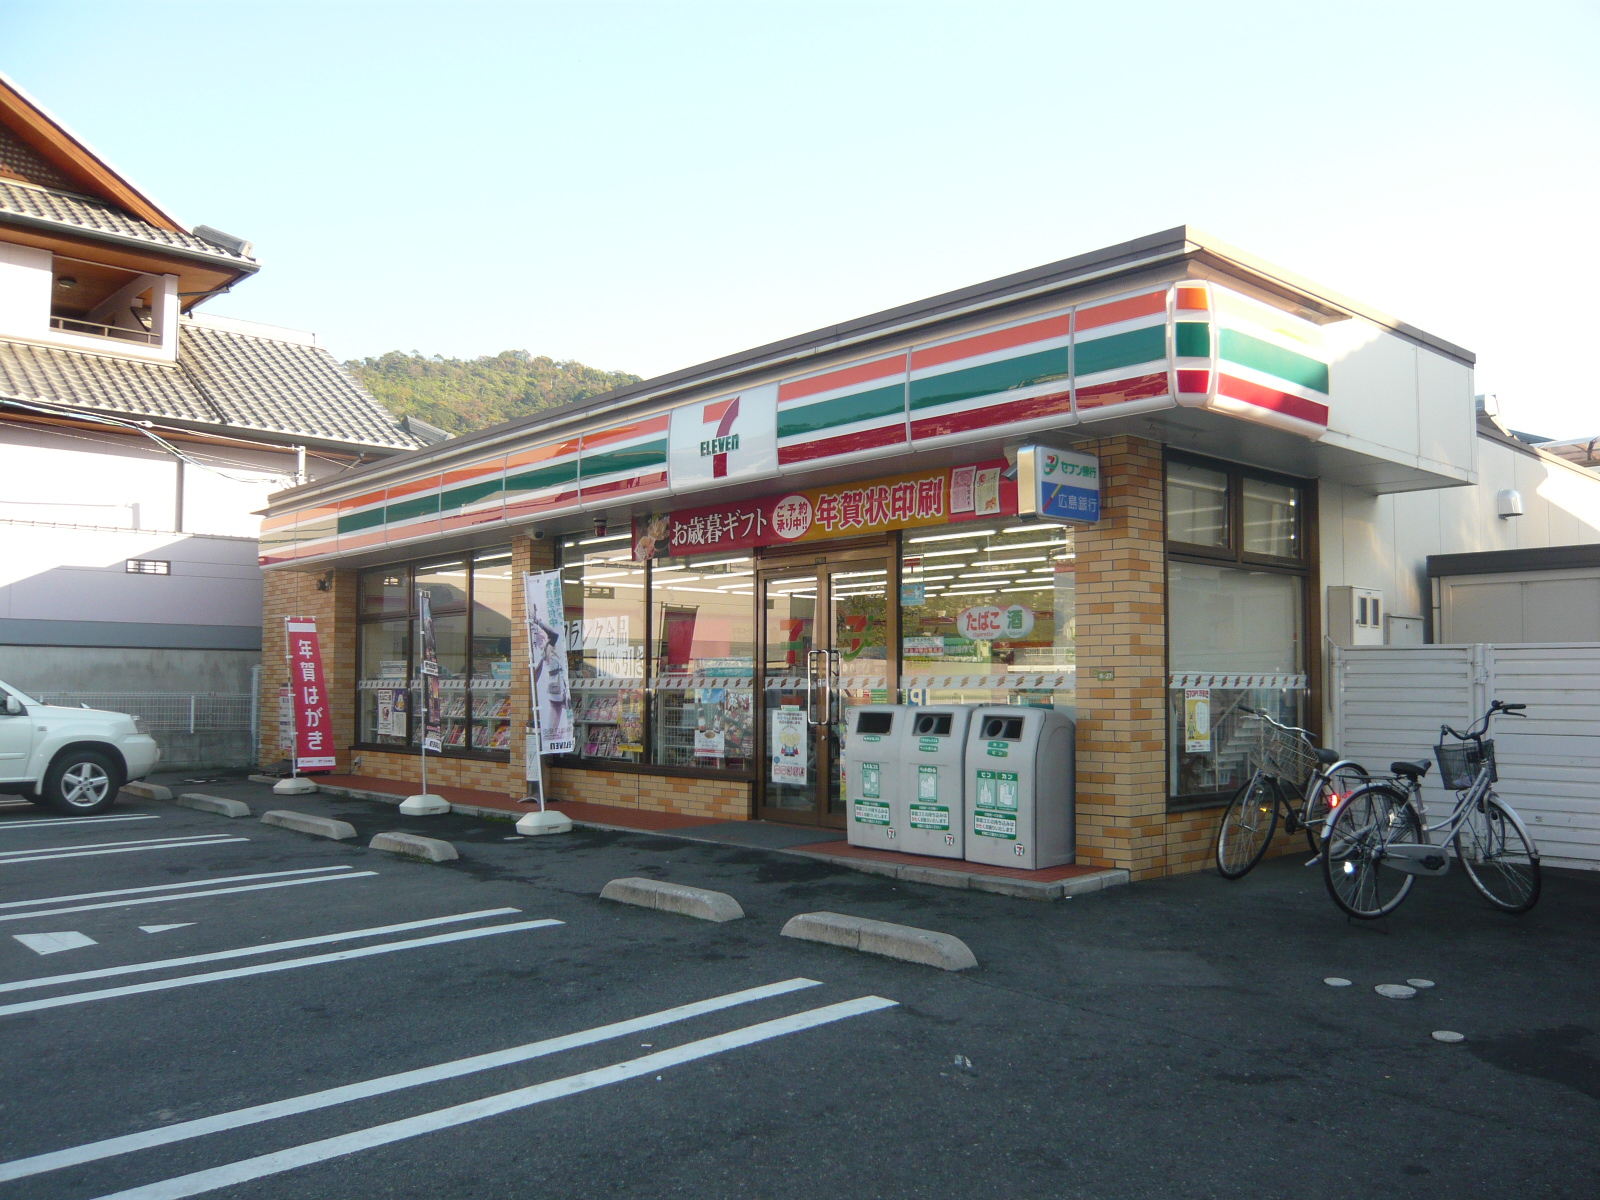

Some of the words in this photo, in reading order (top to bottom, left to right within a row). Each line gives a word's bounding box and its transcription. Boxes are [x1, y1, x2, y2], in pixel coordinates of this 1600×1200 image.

[1061, 461, 1097, 478] セブン銀行
[777, 501, 808, 517] ご予約
[816, 476, 945, 531] 年賀状印刷
[1058, 494, 1097, 512] 広島銀行
[671, 508, 767, 547] お歳暮ギフト
[966, 611, 1000, 631] たばこ
[1007, 609, 1023, 630] 酒
[298, 639, 323, 750] 年賀はがき
